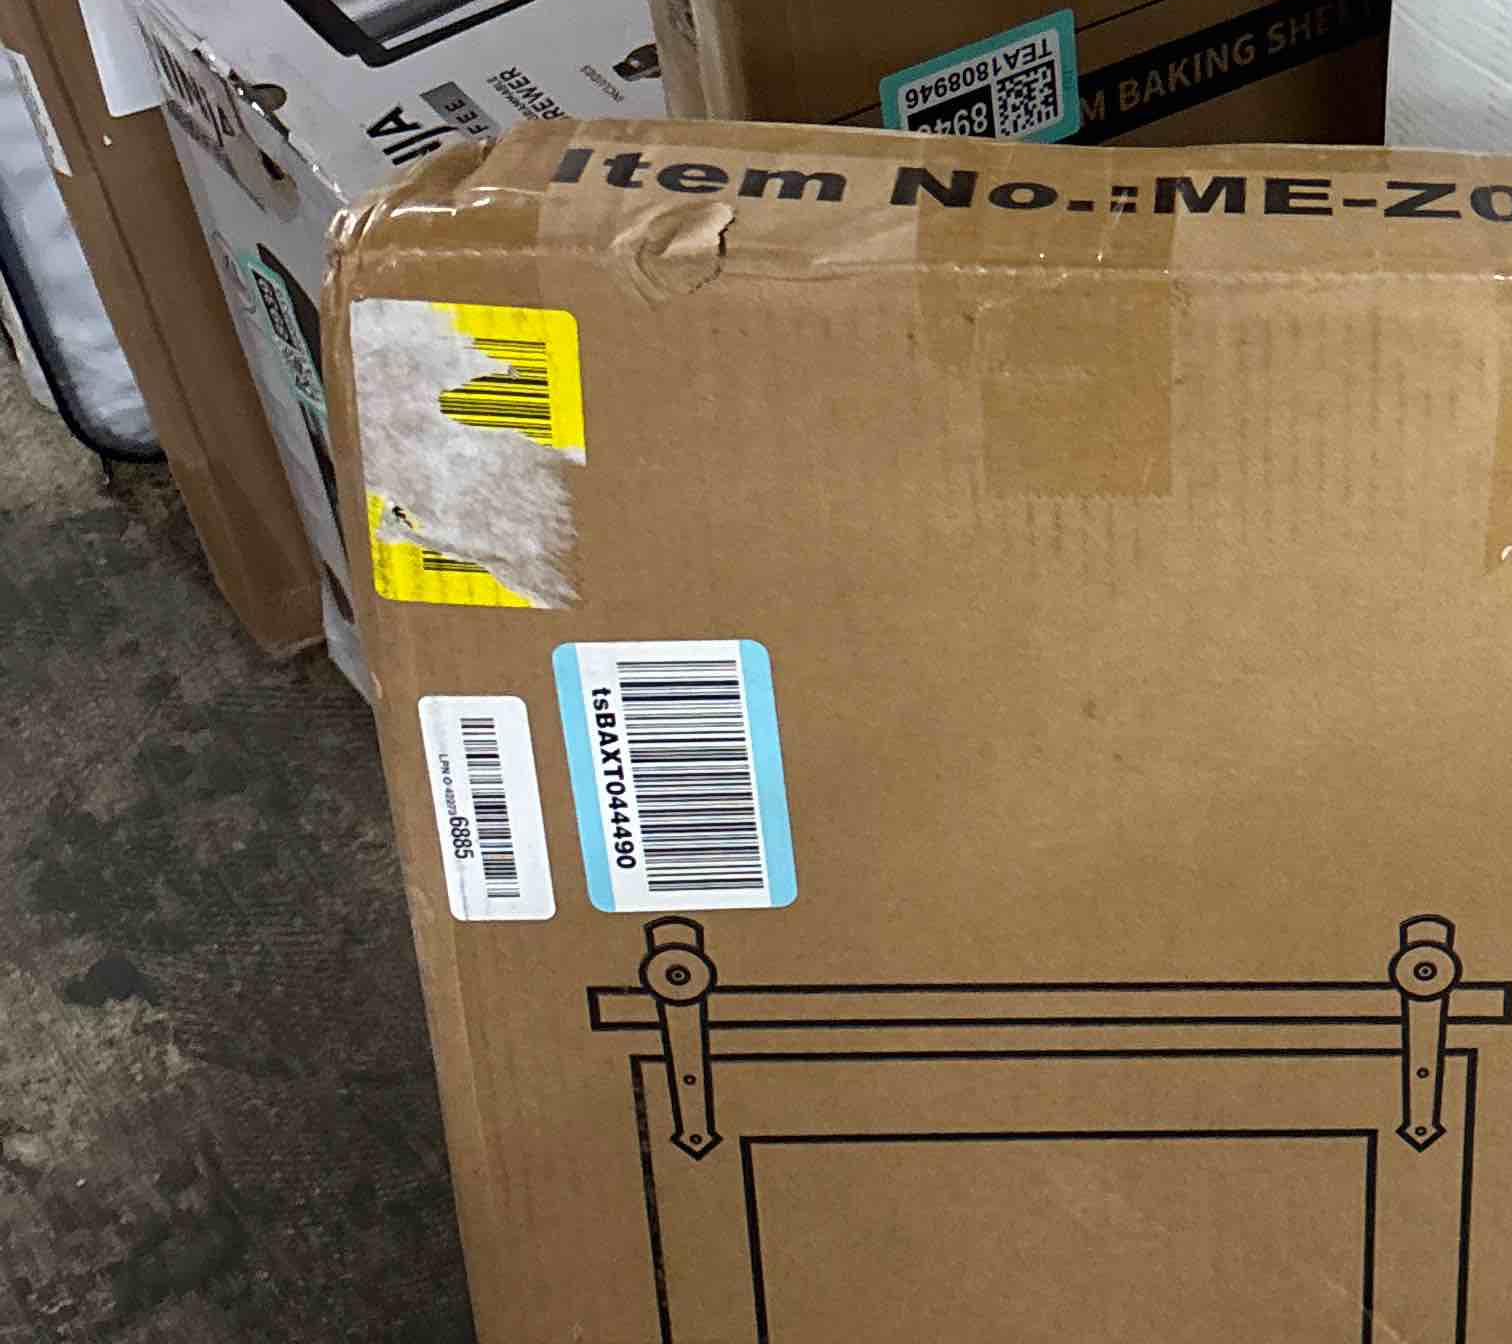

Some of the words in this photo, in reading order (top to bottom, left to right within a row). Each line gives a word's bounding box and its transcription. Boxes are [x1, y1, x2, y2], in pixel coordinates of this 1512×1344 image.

[499, 66, 568, 121] REWER
[905, 38, 1053, 110] TEA1808946
[1117, 32, 1257, 112] BAKING
[550, 148, 848, 203] Item
[591, 686, 638, 870] tsBAXT044490
